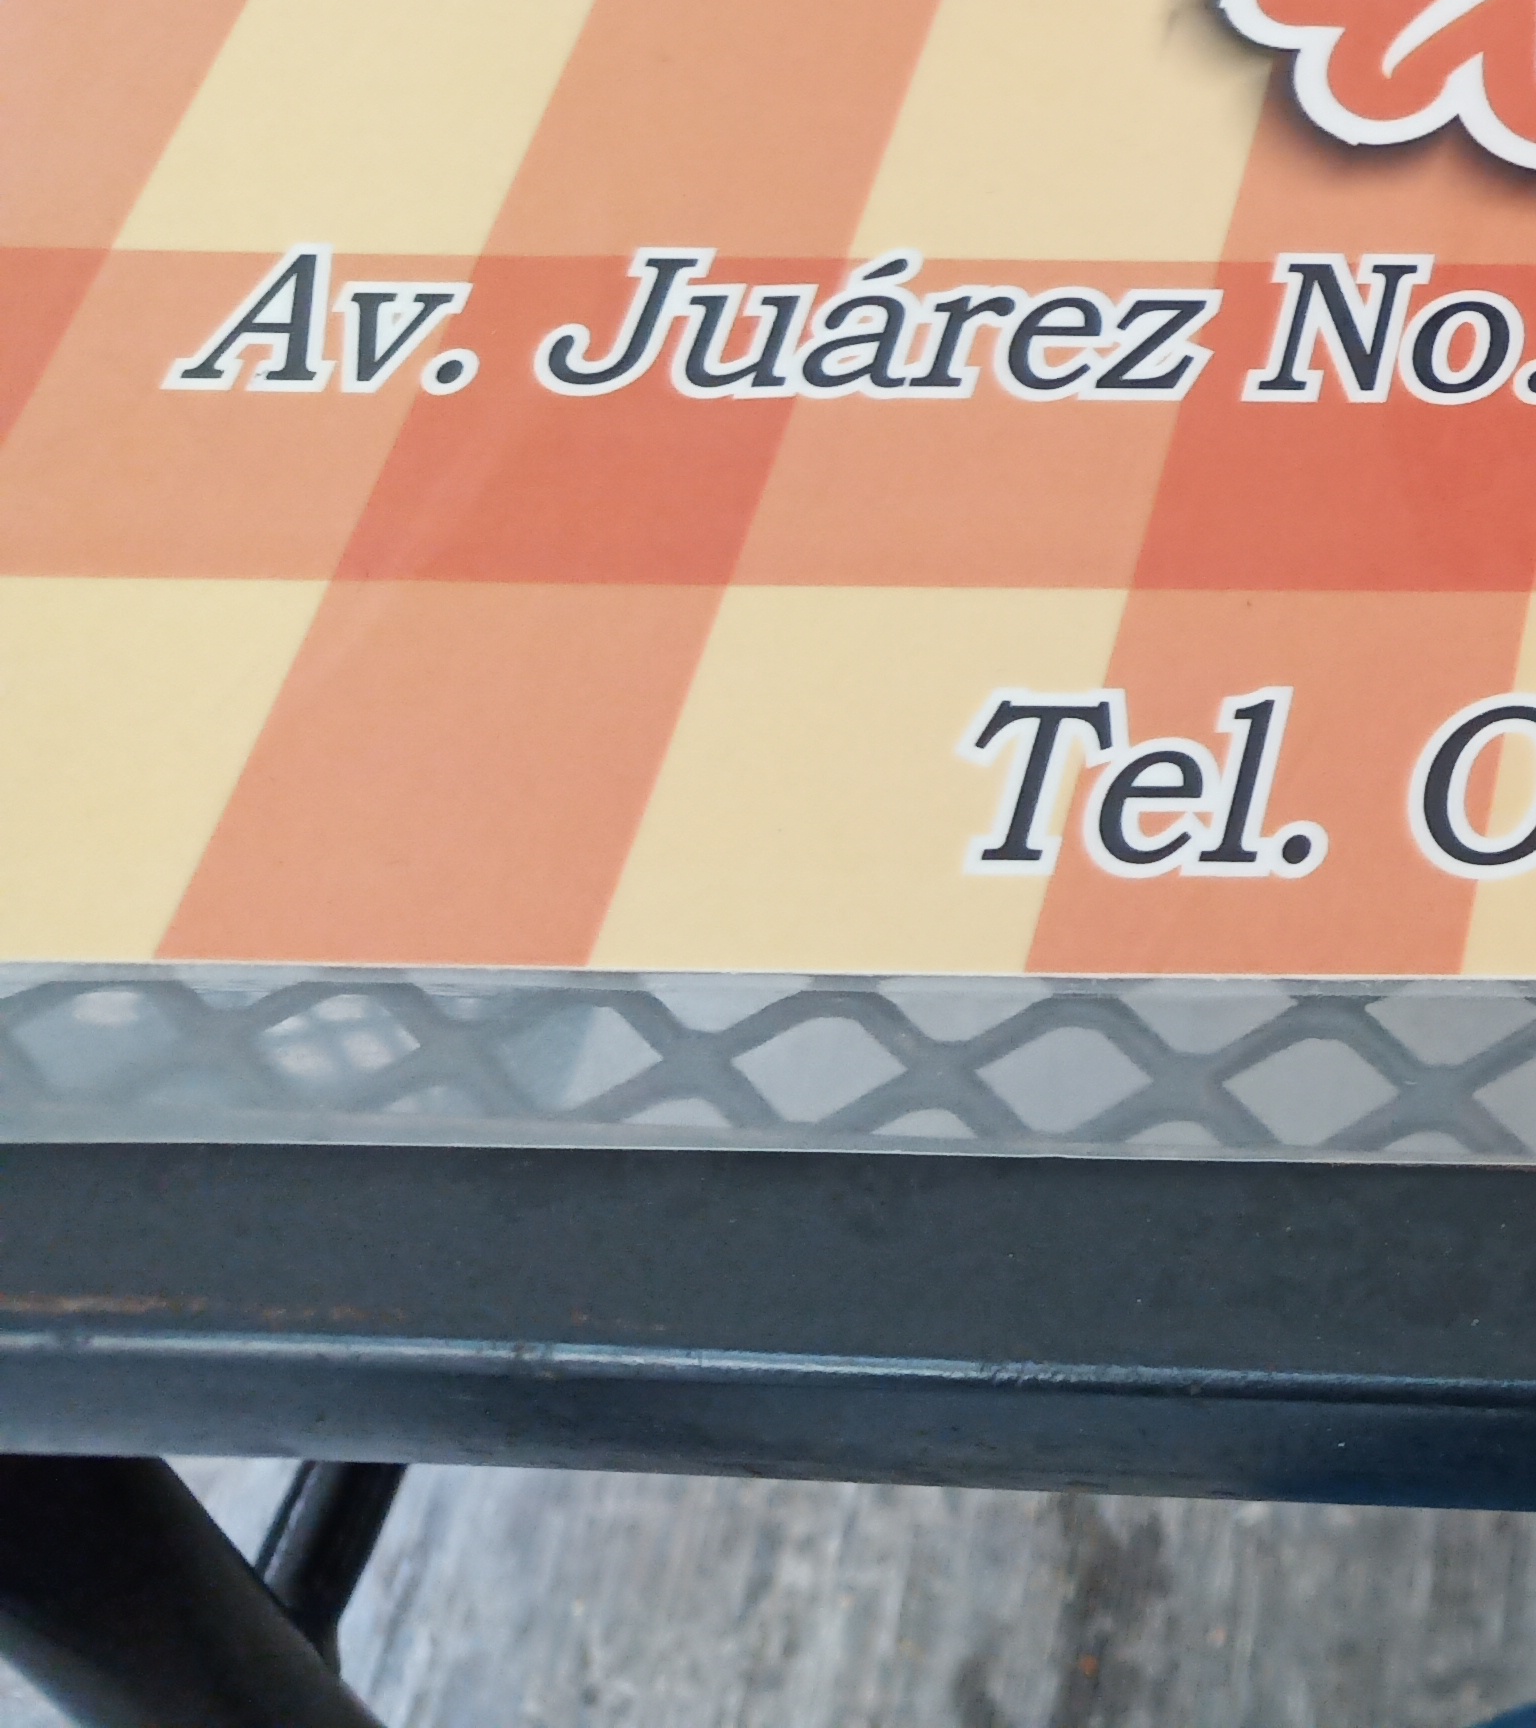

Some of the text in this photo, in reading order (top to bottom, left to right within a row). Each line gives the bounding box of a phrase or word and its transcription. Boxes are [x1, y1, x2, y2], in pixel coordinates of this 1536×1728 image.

[179, 253, 478, 384] Av.
[550, 252, 1207, 390] Juárez
[975, 697, 1314, 866] Tel.
